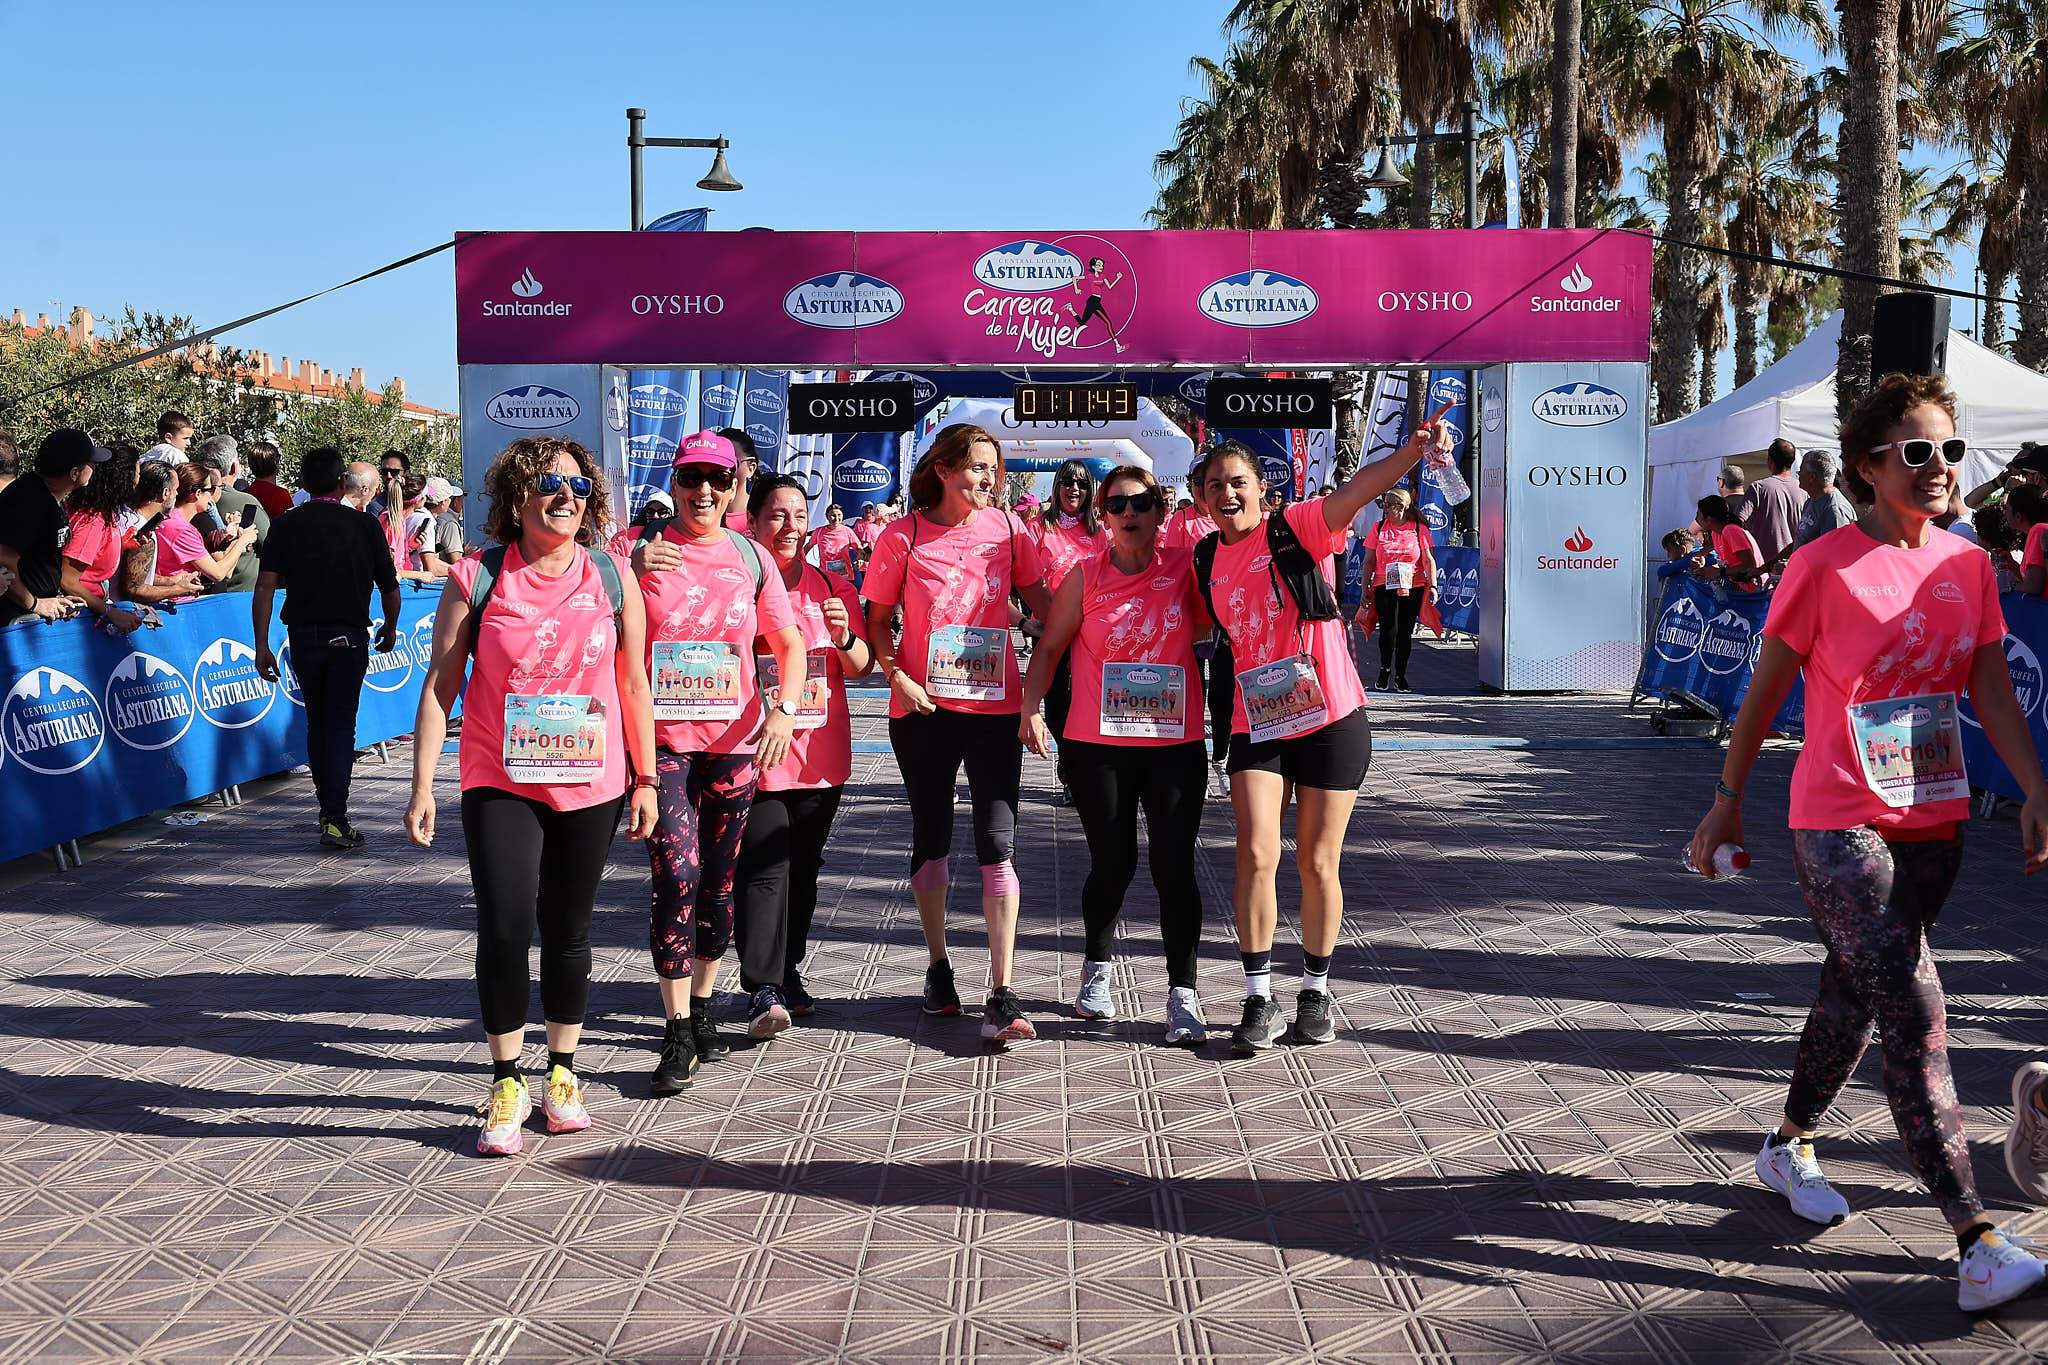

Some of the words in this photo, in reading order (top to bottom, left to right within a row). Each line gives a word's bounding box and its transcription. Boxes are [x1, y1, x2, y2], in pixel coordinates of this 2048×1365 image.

[982, 262, 1074, 280] ASTURIANA
[483, 301, 572, 317] Santander
[632, 295, 724, 315] OYSHO
[793, 296, 894, 315] ASTURIANA
[963, 288, 1054, 317] Carrera
[1208, 294, 1308, 313] ASTURIANA
[1378, 291, 1472, 312] OYSHO
[1531, 296, 1621, 313] Santander
[986, 324, 1003, 336] de
[1005, 323, 1018, 336] la
[1015, 315, 1088, 357] Mujer
[494, 401, 573, 418] ASTURIANA
[749, 395, 780, 410] ASTURIANA
[809, 398, 897, 417] OYSHO
[1226, 394, 1314, 414] OYSHO
[1539, 399, 1620, 416] ASTURIANA
[630, 449, 676, 461] STURIANA
[836, 471, 887, 484] ASTURIANA
[1263, 470, 1288, 480] RIANA
[1529, 466, 1627, 487] OYSHO
[1537, 556, 1620, 570] Santander
[1850, 585, 1898, 597] OYSHO
[497, 602, 539, 616] OYSHO
[1659, 618, 1699, 648] ASTURIANA
[1702, 628, 1746, 660] ASTURIANA
[367, 649, 410, 674] STURIANA
[955, 658, 982, 671] 016
[209, 668, 235, 681] CENTRAL
[236, 665, 257, 677] LECHE
[2009, 668, 2036, 683] ECHERA
[122, 683, 151, 698] CENTRAL
[152, 679, 182, 693] LECHERA
[682, 676, 715, 689] 016
[201, 675, 272, 711] ASTURIANA
[1129, 695, 1159, 708] 016
[1268, 692, 1296, 709] 016
[22, 703, 57, 718] CENTRAL
[57, 697, 90, 711] LECHERA
[114, 693, 190, 730] ASTURIANA
[661, 708, 690, 716] OYSHO
[12, 711, 101, 754] ASTURIANA
[1260, 726, 1284, 737] OYSHO
[538, 734, 575, 749] 016
[1901, 743, 1935, 762] 016
[514, 770, 546, 778] OYSHO
[1878, 778, 1903, 789] ARRERA
